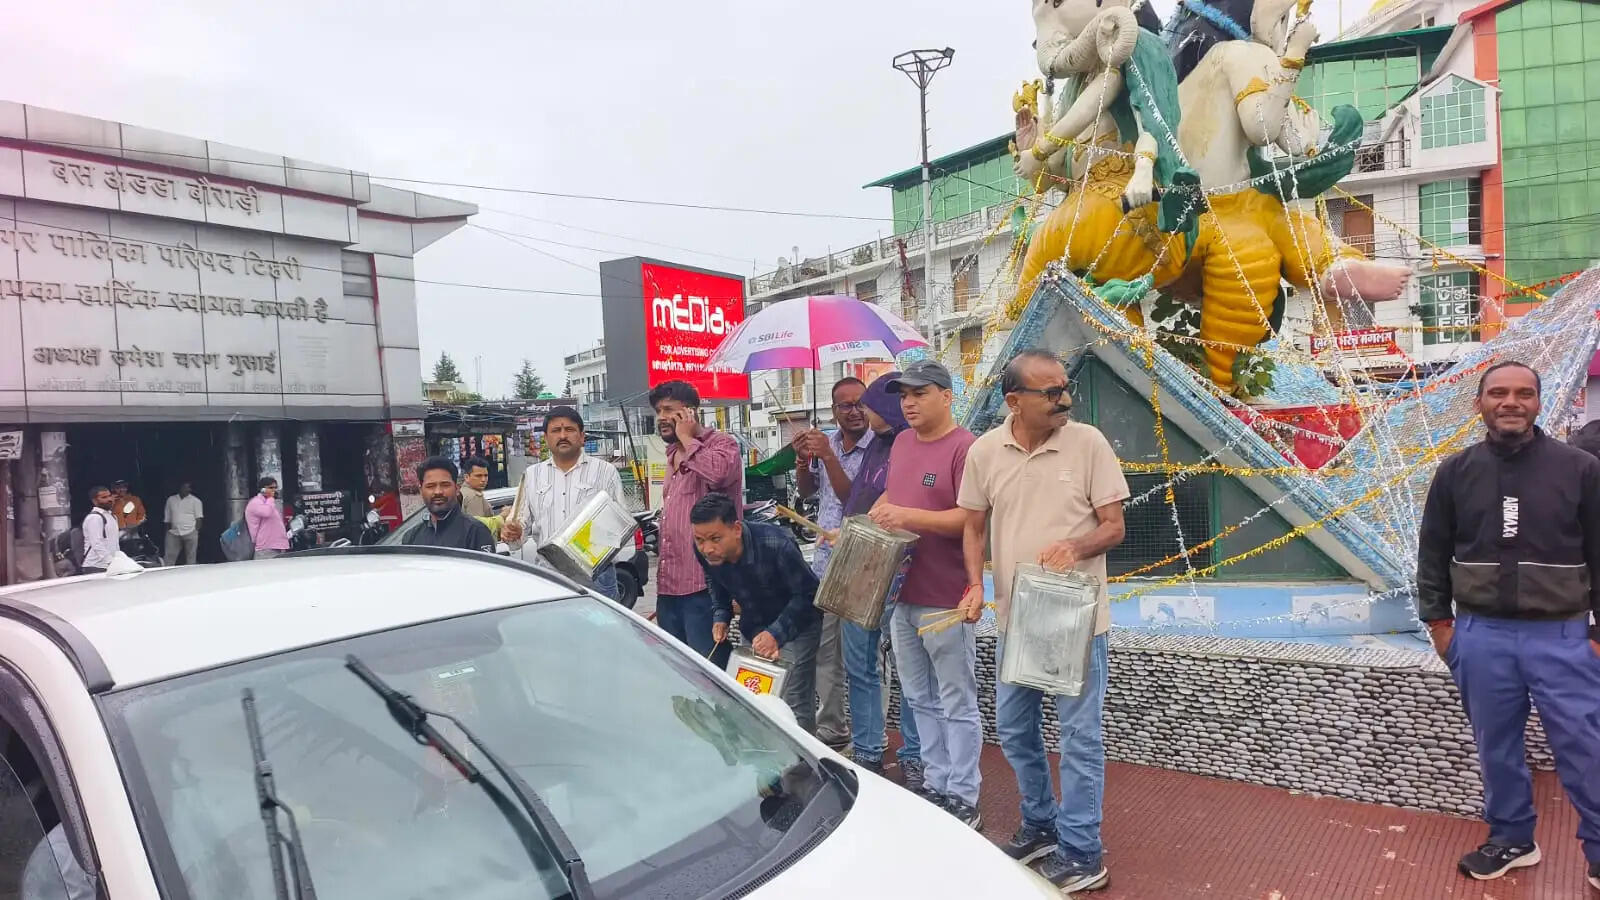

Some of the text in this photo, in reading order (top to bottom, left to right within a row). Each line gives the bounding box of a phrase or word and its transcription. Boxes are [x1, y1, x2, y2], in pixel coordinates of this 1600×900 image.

[49, 159, 95, 188] बस
[186, 176, 262, 216] बौराड़ी
[0, 229, 302, 281] गर पालिका परिषद टिहरी
[0, 279, 329, 324] पका हार्दिक स्वागत करती है
[1438, 275, 1452, 342] HOTEL
[32, 346, 102, 366] अध्यक्ष
[109, 344, 164, 368] उमेश
[171, 351, 220, 370] चरण
[1503, 496, 1519, 535] AIRMAX
